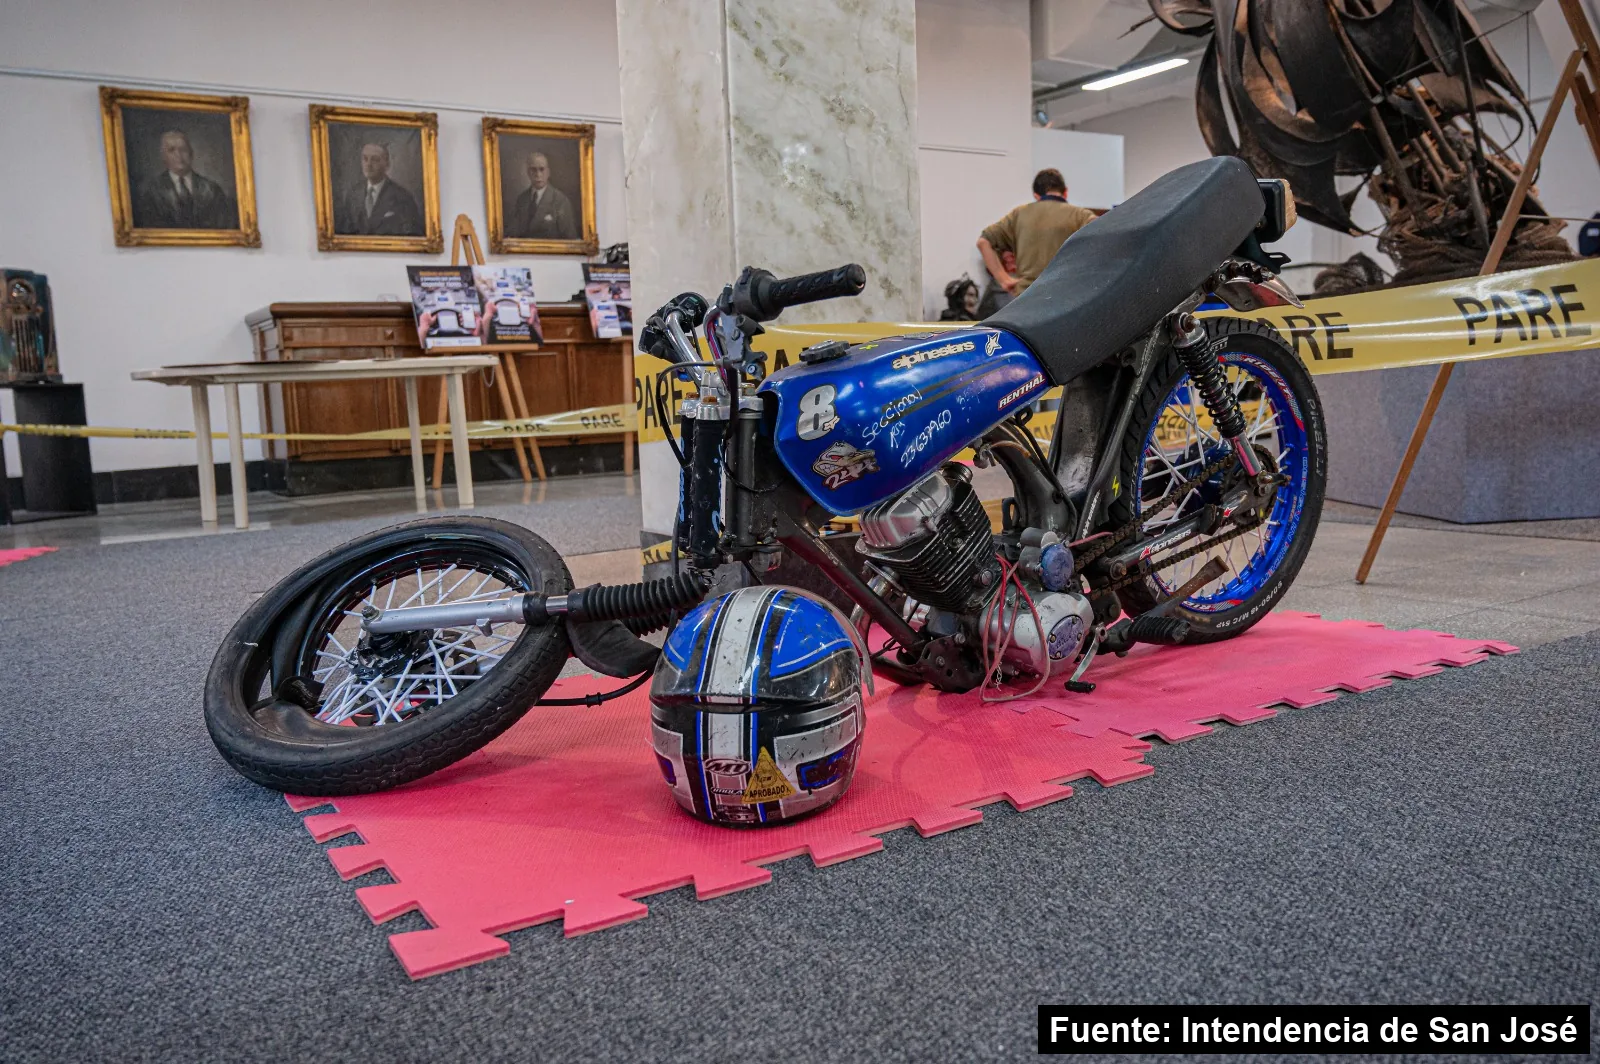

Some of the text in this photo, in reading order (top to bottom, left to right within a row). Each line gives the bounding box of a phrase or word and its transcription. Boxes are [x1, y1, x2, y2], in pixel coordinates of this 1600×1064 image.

[1256, 311, 1354, 361] RE
[1453, 284, 1592, 346] PARE
[891, 341, 975, 370] alpinestars
[796, 384, 836, 441] 8
[861, 384, 923, 446] Seccional
[998, 373, 1046, 410] RENTHAL
[580, 412, 626, 430] PARE
[1306, 398, 1325, 478] PIRELLI
[749, 784, 785, 798] APROBADO
